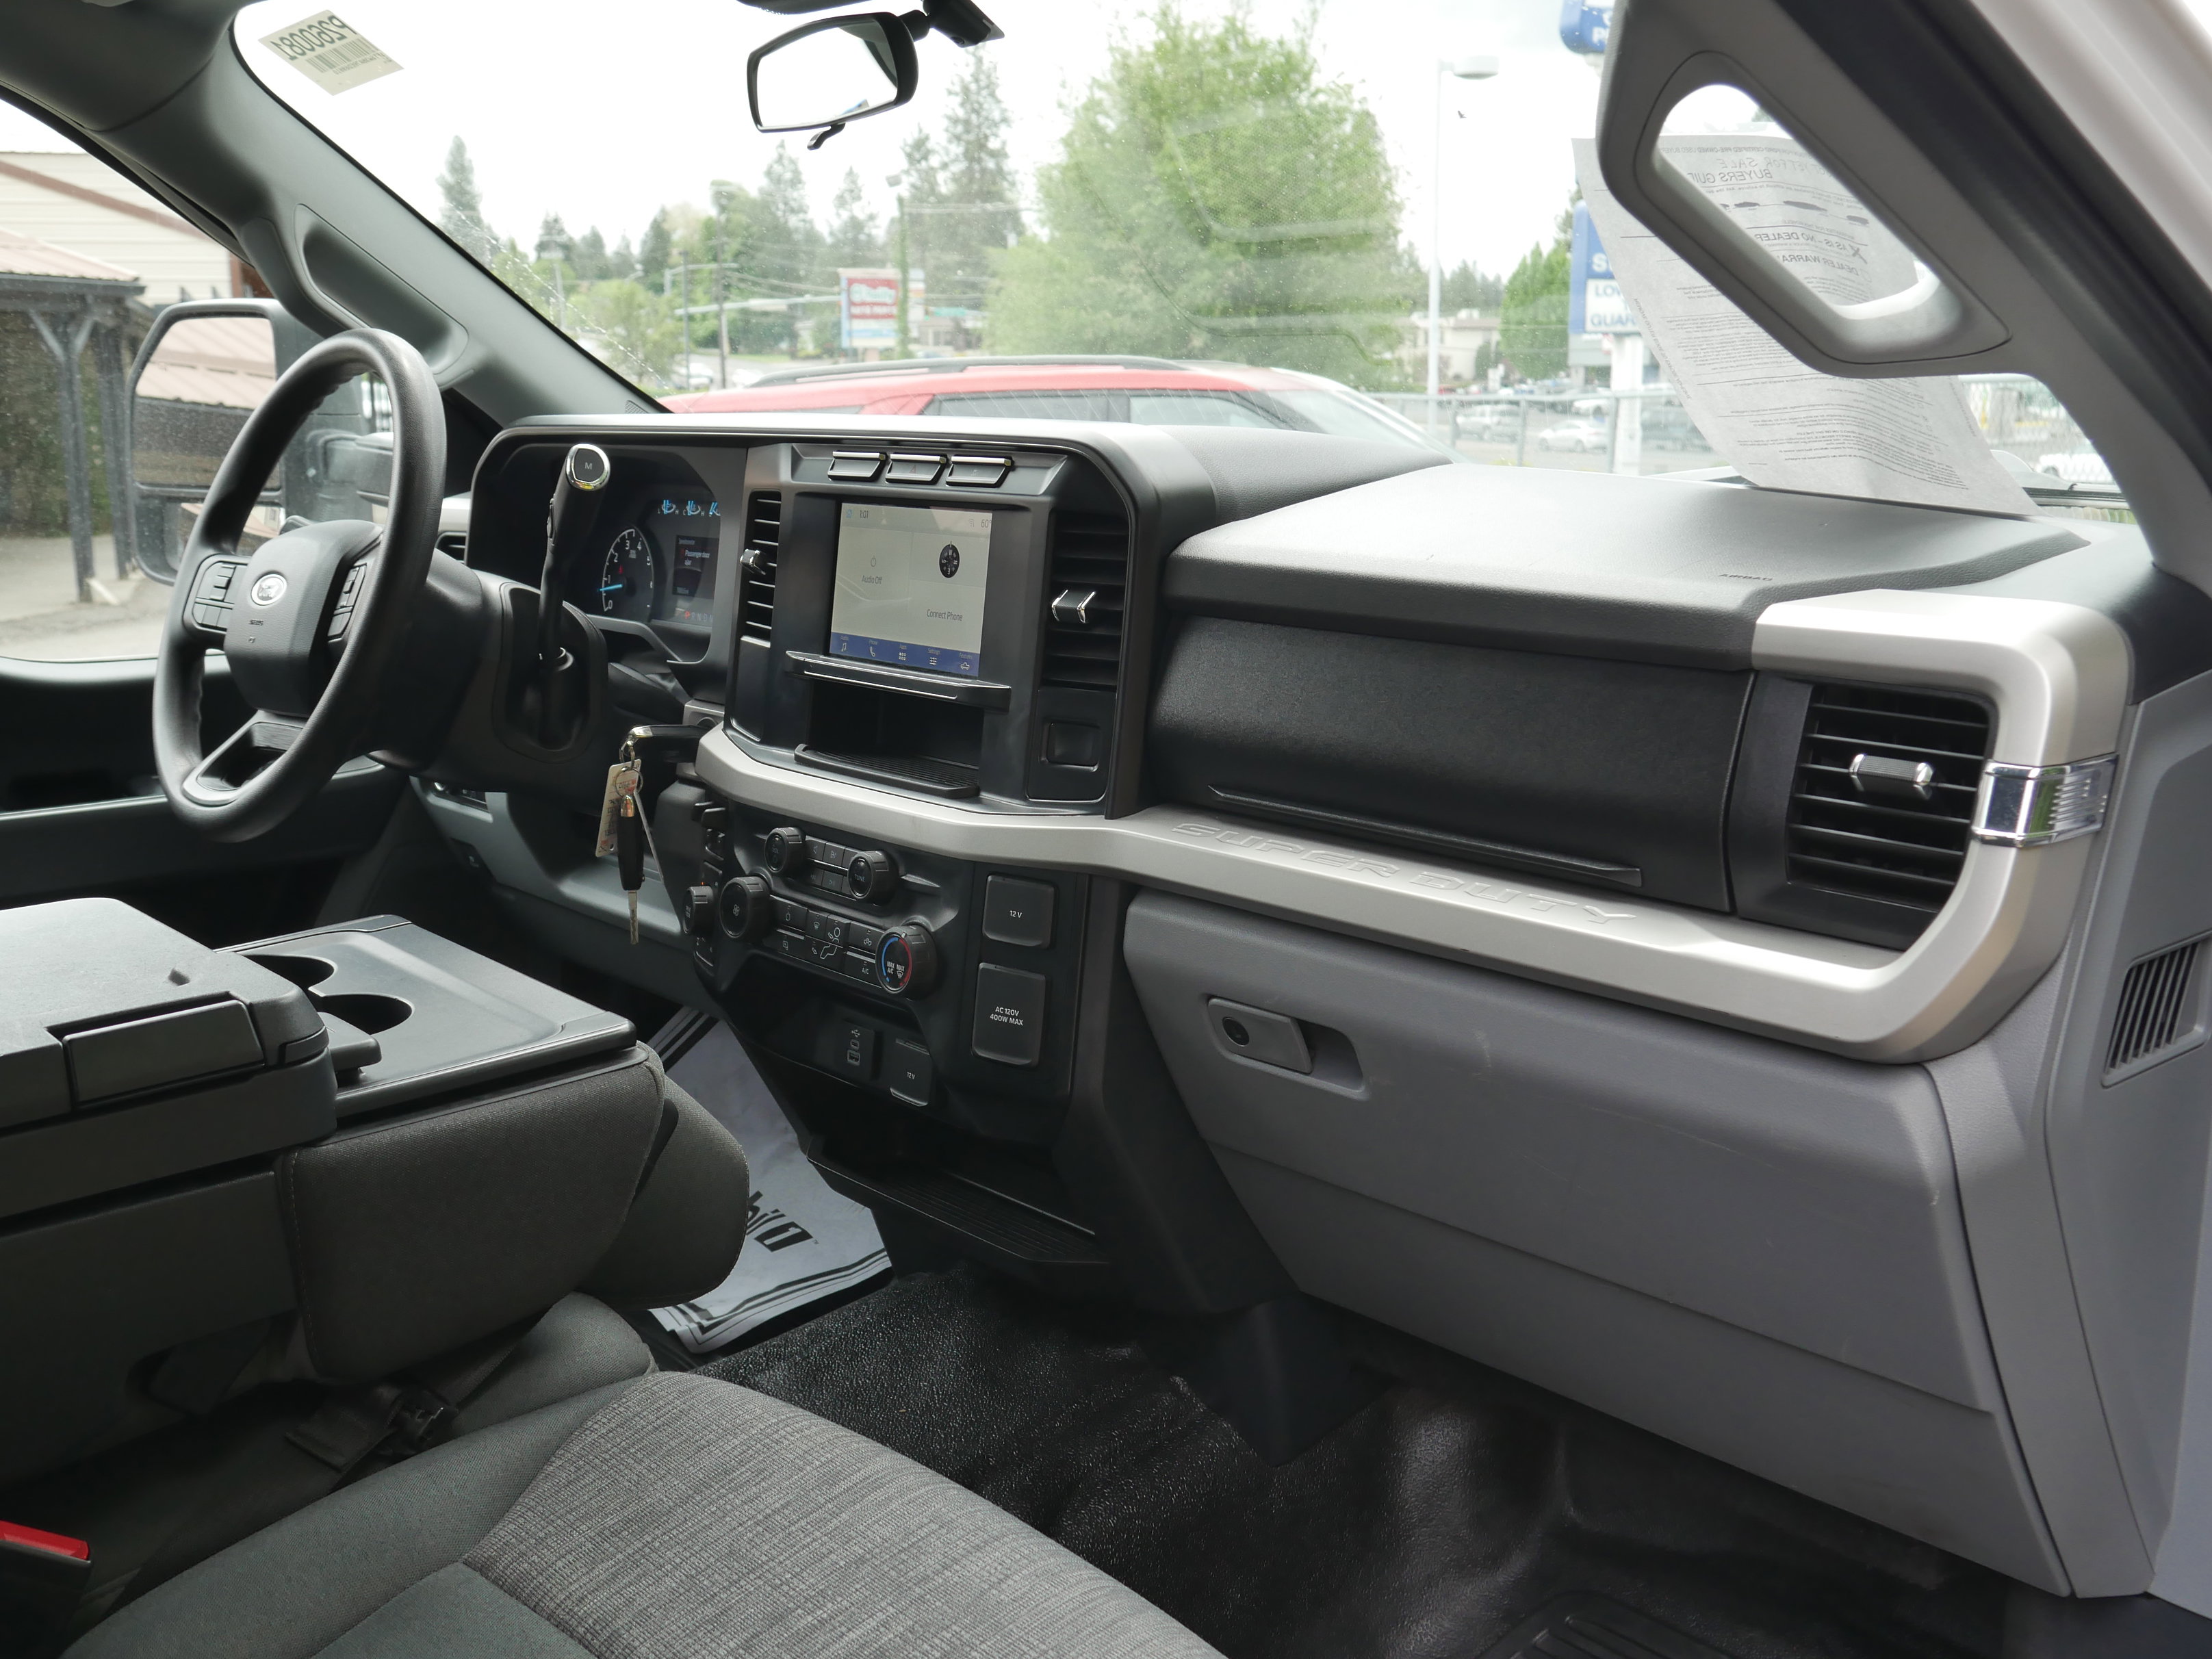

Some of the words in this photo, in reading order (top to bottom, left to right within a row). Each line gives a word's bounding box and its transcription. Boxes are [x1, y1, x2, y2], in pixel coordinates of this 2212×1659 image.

[584, 461, 593, 470] M
[626, 539, 630, 550] 3
[613, 552, 619, 563] 2
[862, 575, 875, 584] Audio
[927, 608, 946, 619] Connect
[947, 610, 963, 622] Phone
[855, 874, 866, 882] TUNE
[1172, 822, 1401, 878] SUPER
[1408, 870, 1637, 925] DUTY
[1009, 910, 1016, 918] 12
[887, 961, 895, 969] MAX
[896, 964, 905, 973] MAX
[995, 1006, 1004, 1014] AC
[1004, 1007, 1019, 1017] 120V
[990, 1014, 1008, 1023] 400W
[1009, 1017, 1024, 1027] MAX
